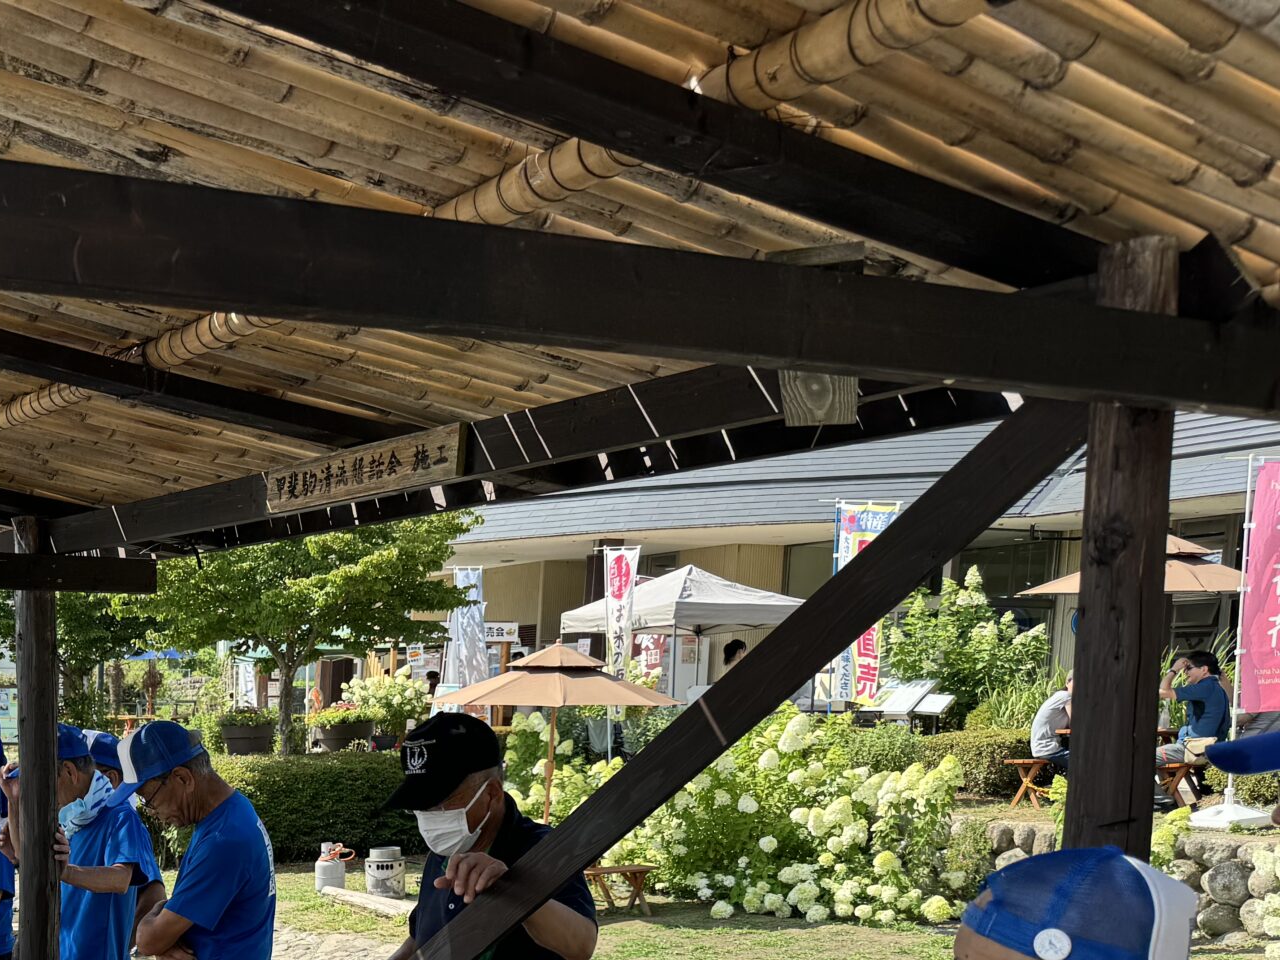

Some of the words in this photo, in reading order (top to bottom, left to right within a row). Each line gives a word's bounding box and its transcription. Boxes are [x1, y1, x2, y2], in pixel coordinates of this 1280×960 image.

[275, 450, 402, 501] 甲斐駒清流懇話会
[411, 444, 449, 473] 施工
